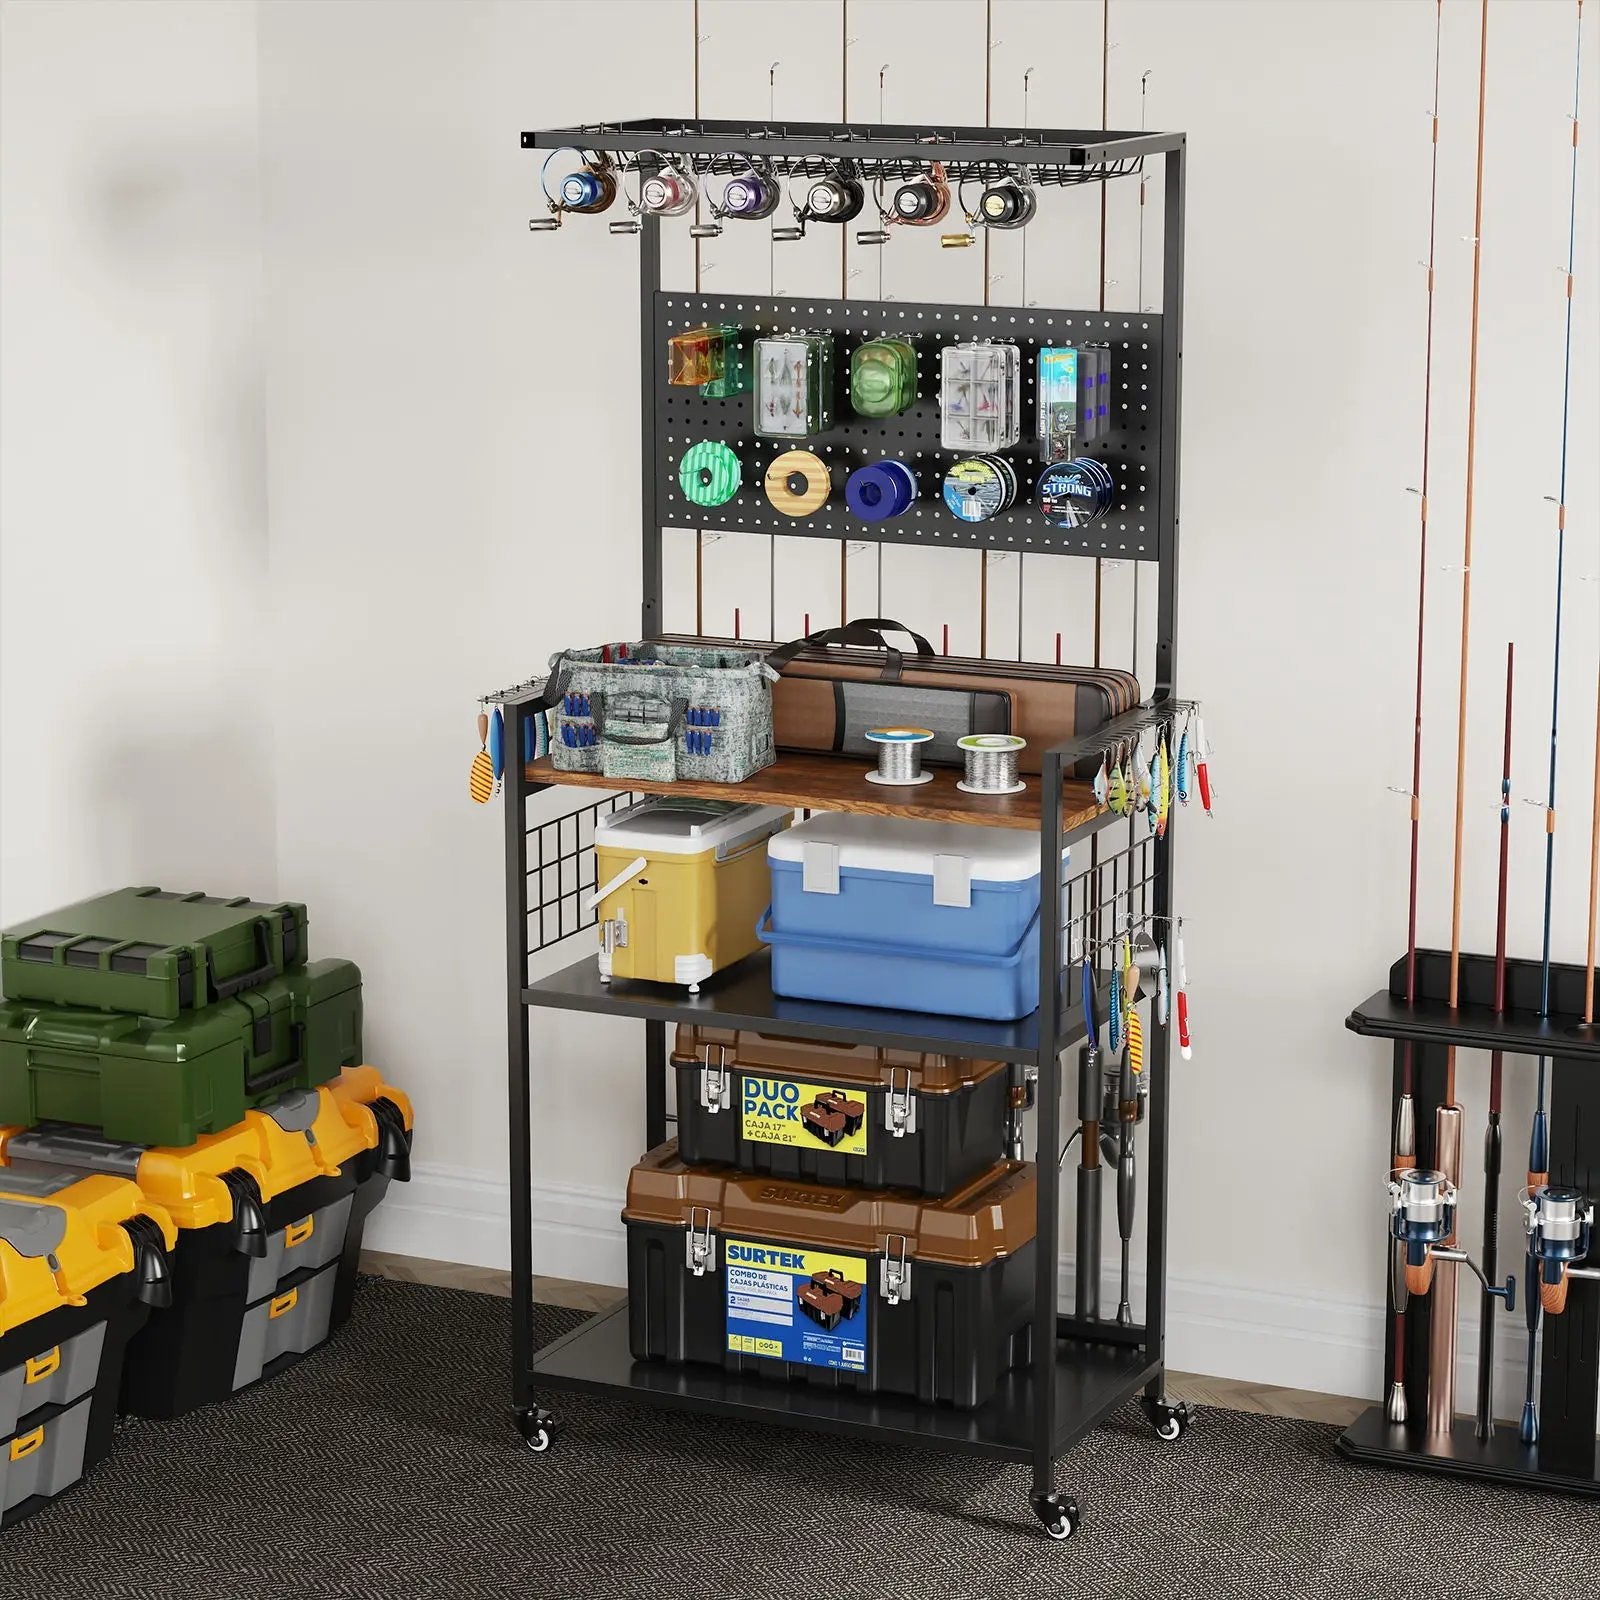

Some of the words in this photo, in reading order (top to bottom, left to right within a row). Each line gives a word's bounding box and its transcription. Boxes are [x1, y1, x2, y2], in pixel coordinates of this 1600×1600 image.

[1041, 482, 1092, 497] STRONG
[744, 1079, 800, 1103] DUO
[744, 1101, 799, 1122] PACK
[745, 1120, 771, 1130] CAJA
[754, 1130, 780, 1140] CAJA
[727, 1245, 806, 1270] SURTEK
[730, 1269, 758, 1279] COMBO
[758, 1273, 767, 1281] DE
[730, 1278, 752, 1287] CAJAS
[753, 1280, 788, 1292] PLÁSTICAS
[729, 1295, 736, 1304] 2
